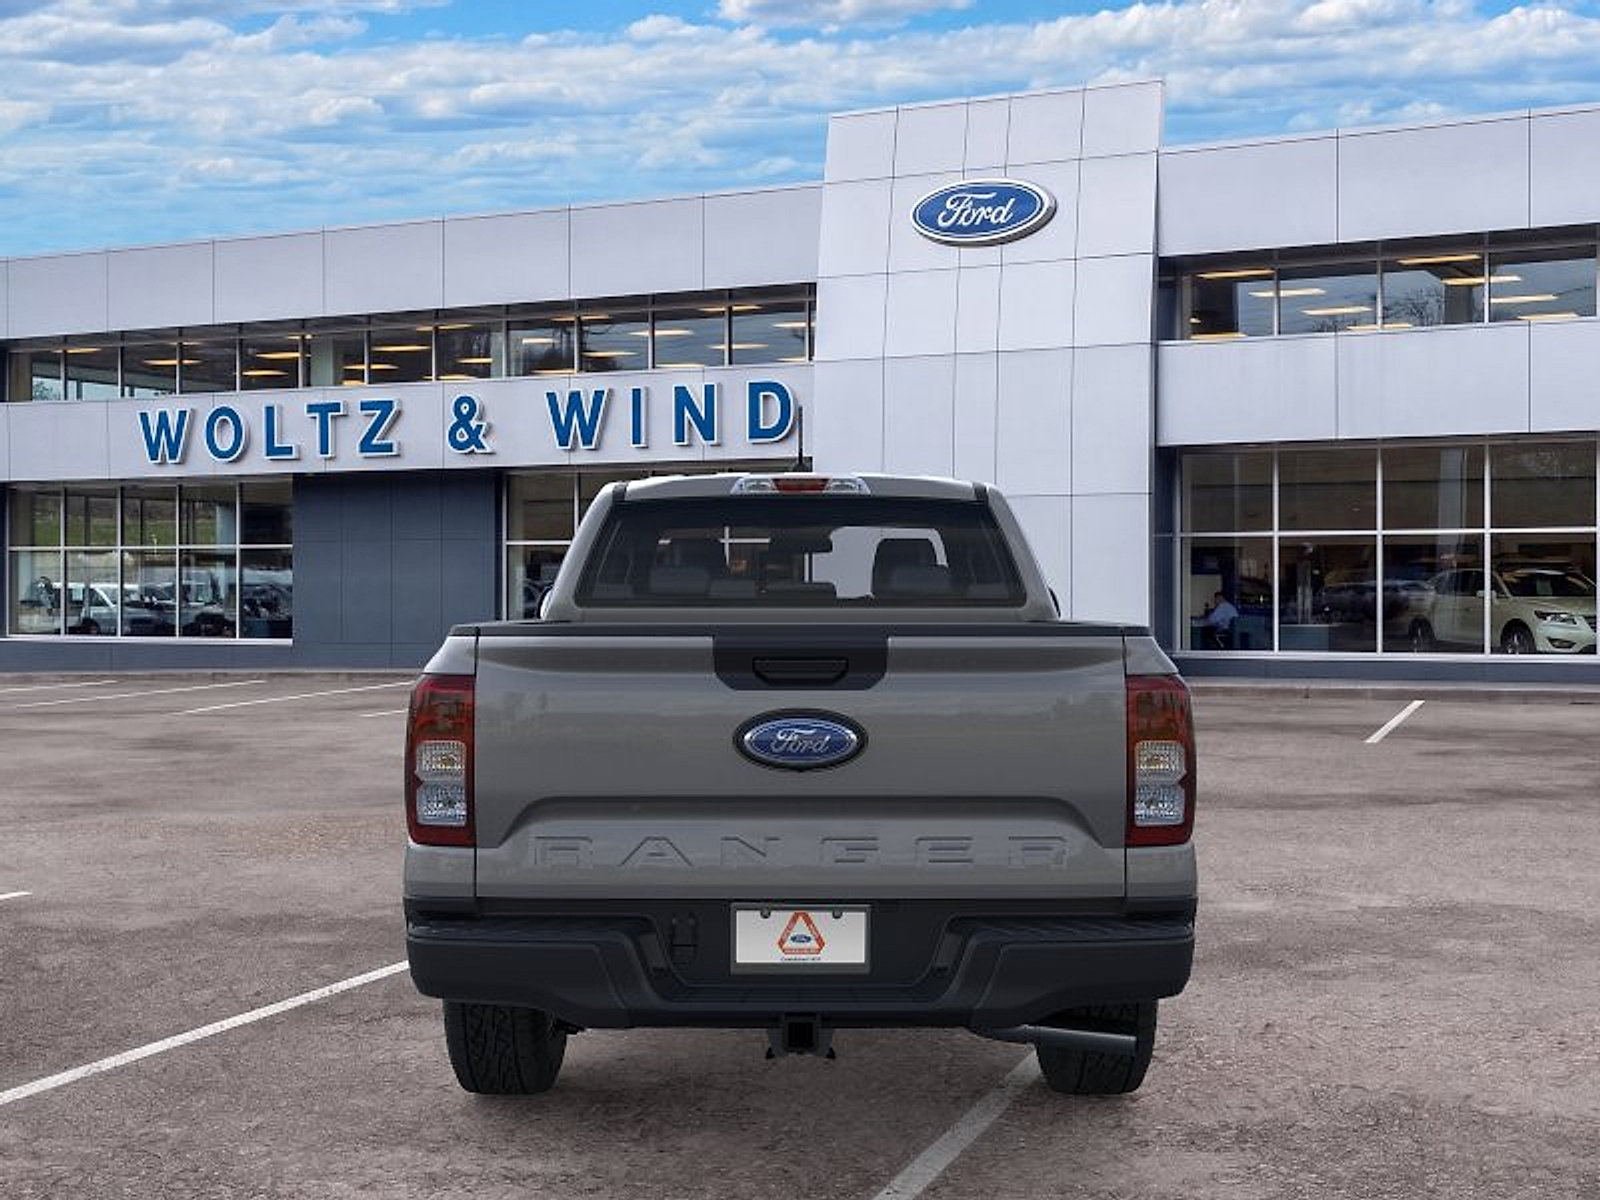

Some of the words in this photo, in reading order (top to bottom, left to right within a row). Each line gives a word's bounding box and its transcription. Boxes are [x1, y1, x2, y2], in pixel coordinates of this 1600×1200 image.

[938, 192, 1015, 228] Ford
[139, 399, 402, 464] WOLTZ
[448, 394, 494, 455] &
[546, 380, 796, 449] WIND
[770, 727, 830, 754] Ford
[534, 835, 1070, 868] RANGER
